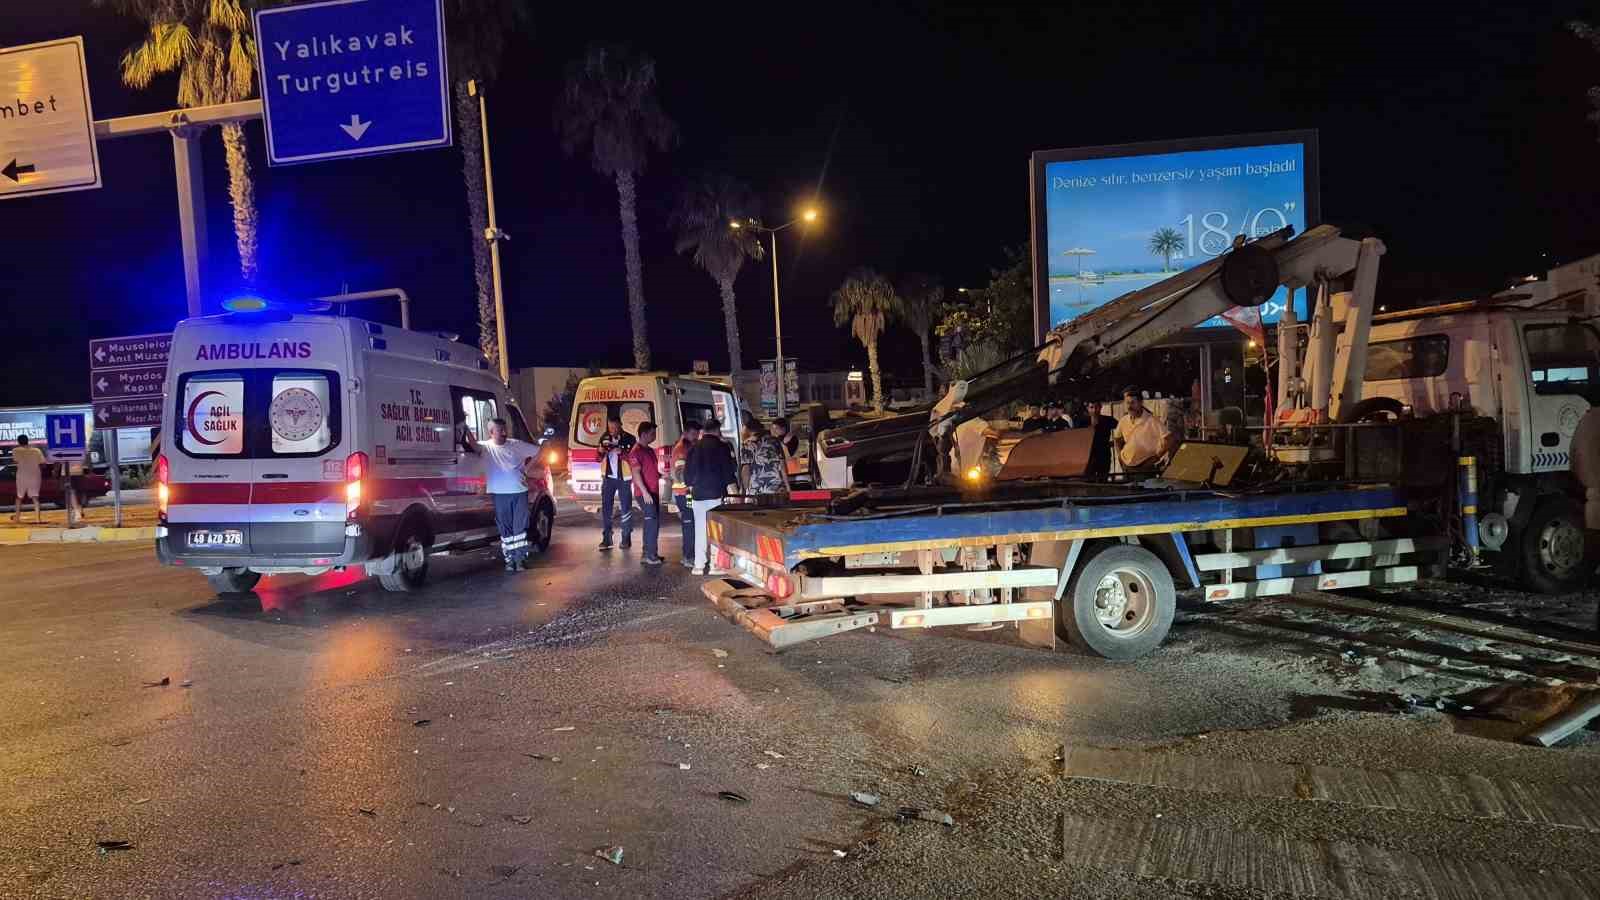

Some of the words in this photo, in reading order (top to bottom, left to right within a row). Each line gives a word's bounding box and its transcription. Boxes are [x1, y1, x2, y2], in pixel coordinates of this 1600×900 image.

[274, 25, 413, 61] Yalıkavak
[278, 60, 428, 94] Turgutreis
[1053, 175, 1096, 191] Denize
[1132, 168, 1194, 184] benzersiz
[1199, 165, 1240, 182] yaşam
[196, 341, 312, 361] AMBULANS
[119, 371, 162, 383] Myndos
[409, 389, 425, 406] T.C.
[584, 389, 645, 401] AMBULANS
[210, 404, 231, 417] ACİL
[380, 402, 410, 422] SAĞLIK
[204, 418, 238, 432] SAĞLIK
